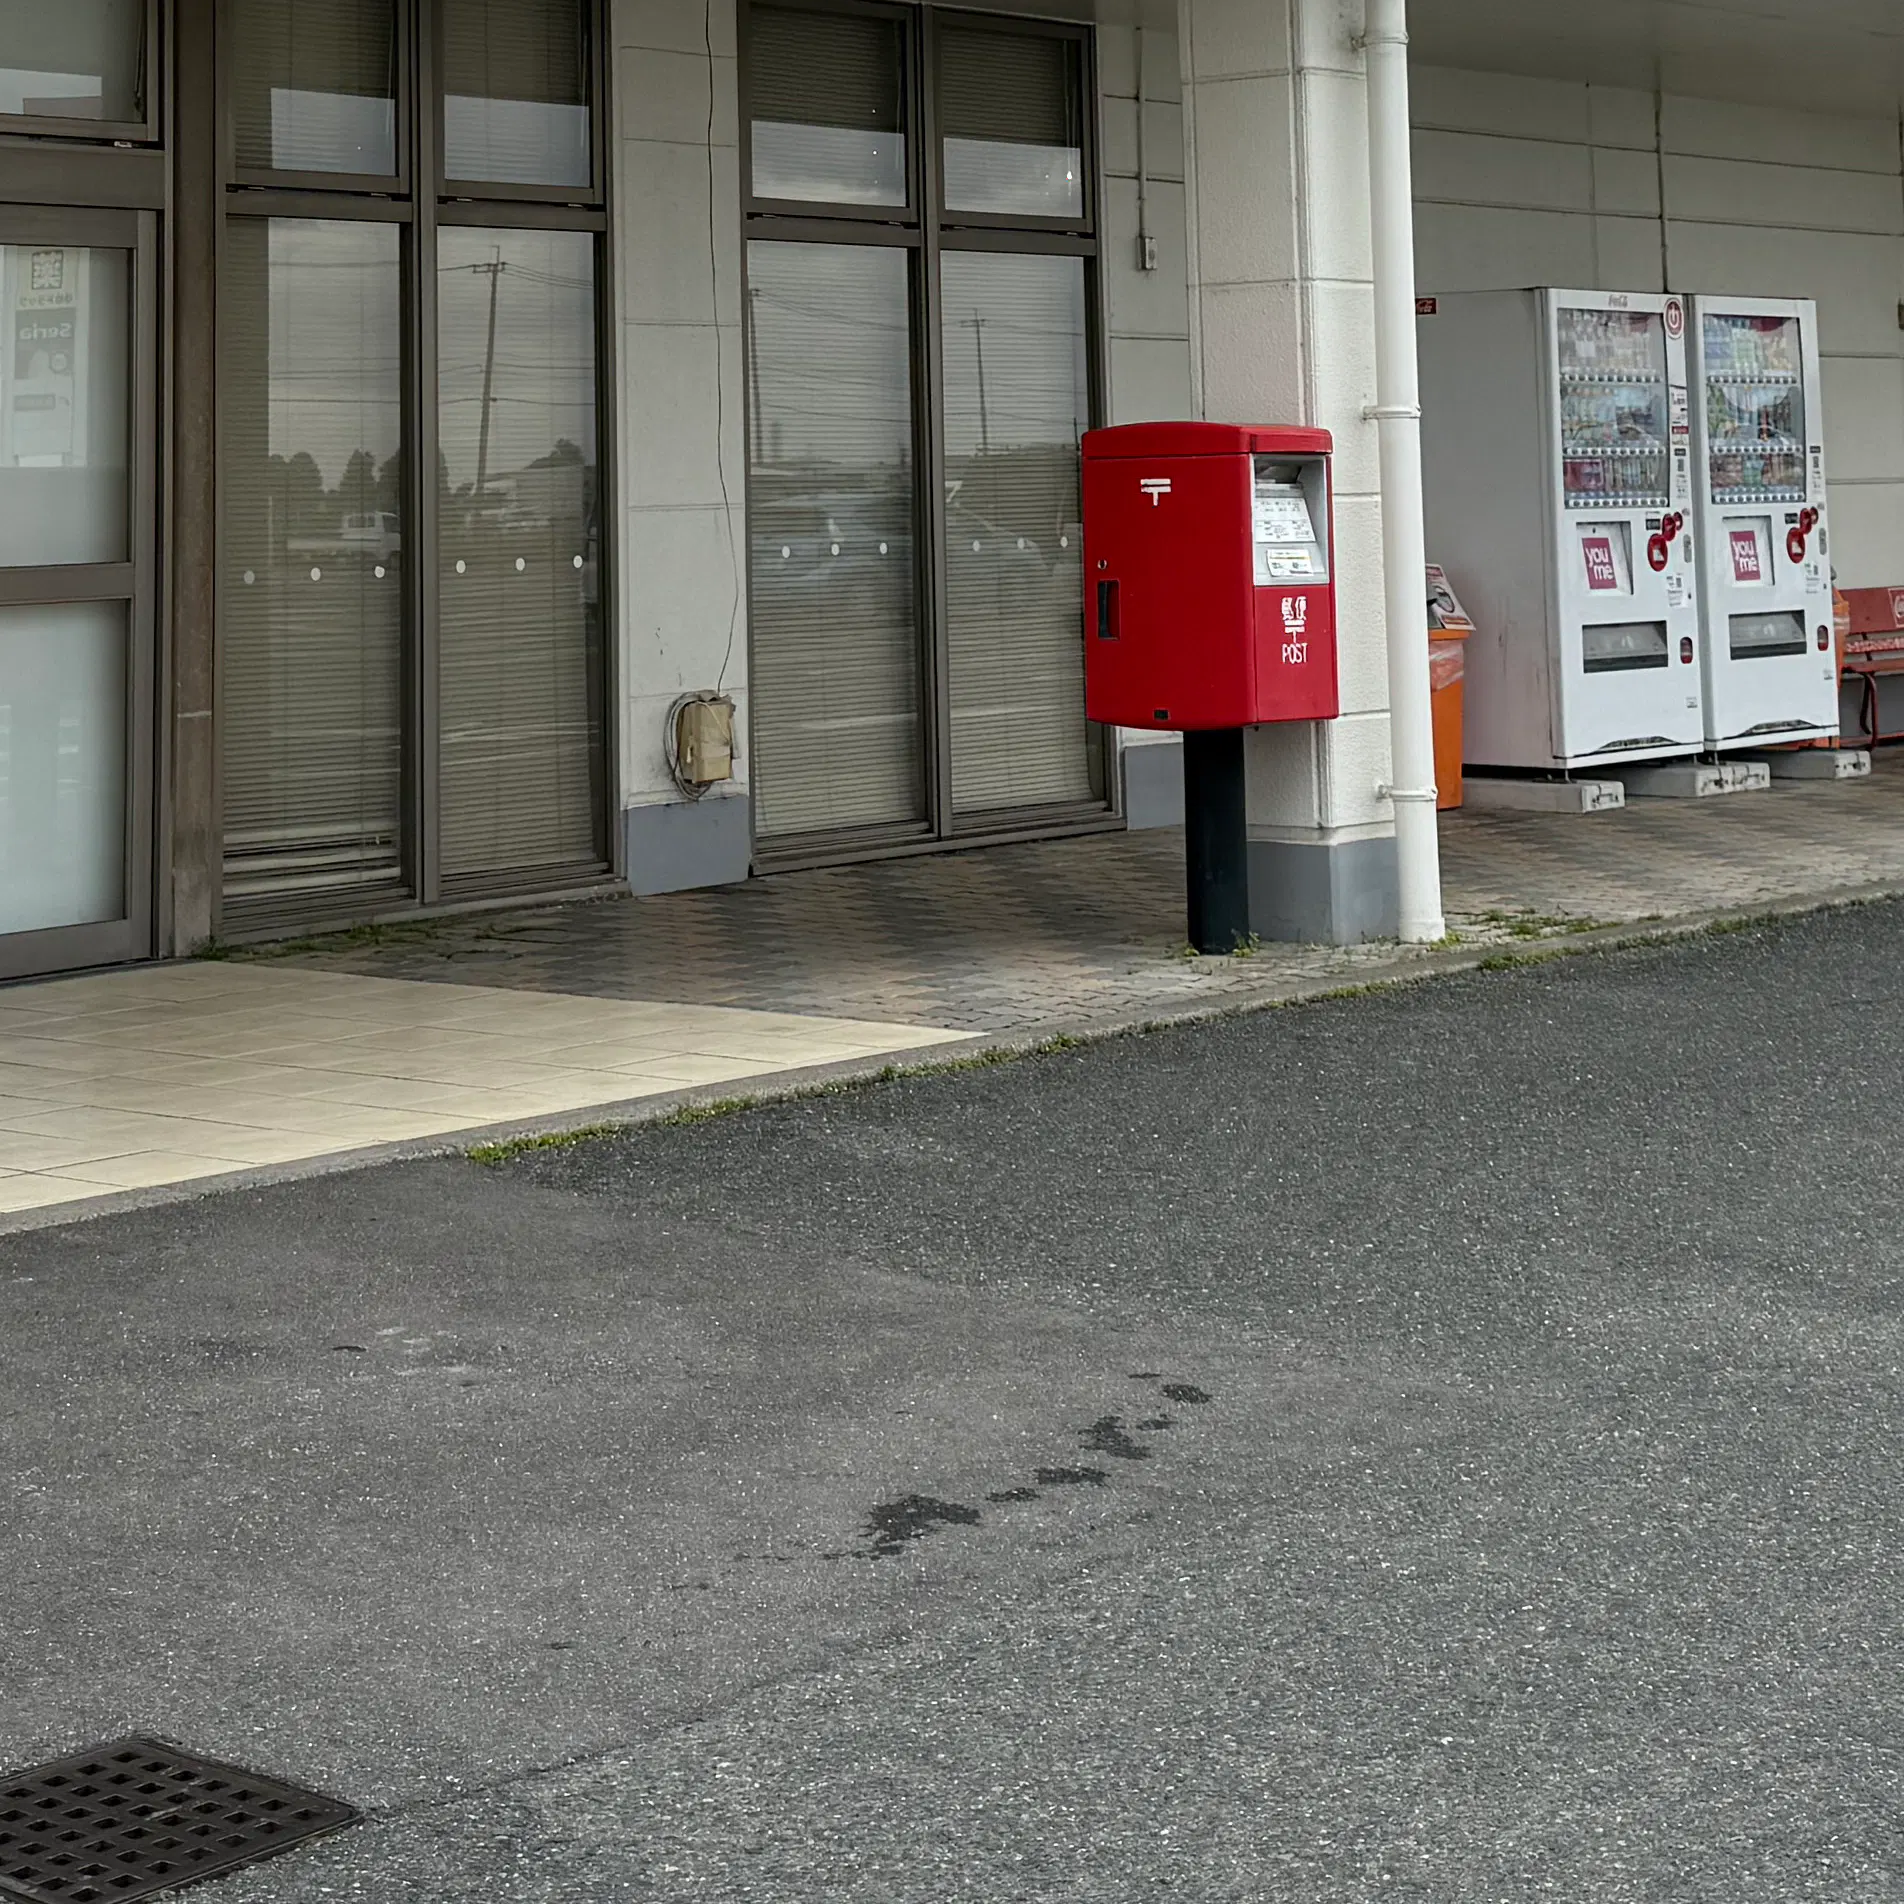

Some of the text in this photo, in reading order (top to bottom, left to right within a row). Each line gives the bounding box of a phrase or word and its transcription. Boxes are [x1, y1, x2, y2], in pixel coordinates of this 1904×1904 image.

[1584, 547, 1610, 567] you
[1732, 540, 1755, 562] you
[1593, 563, 1615, 581] me
[1738, 555, 1759, 573] me
[1281, 643, 1308, 664] POST
